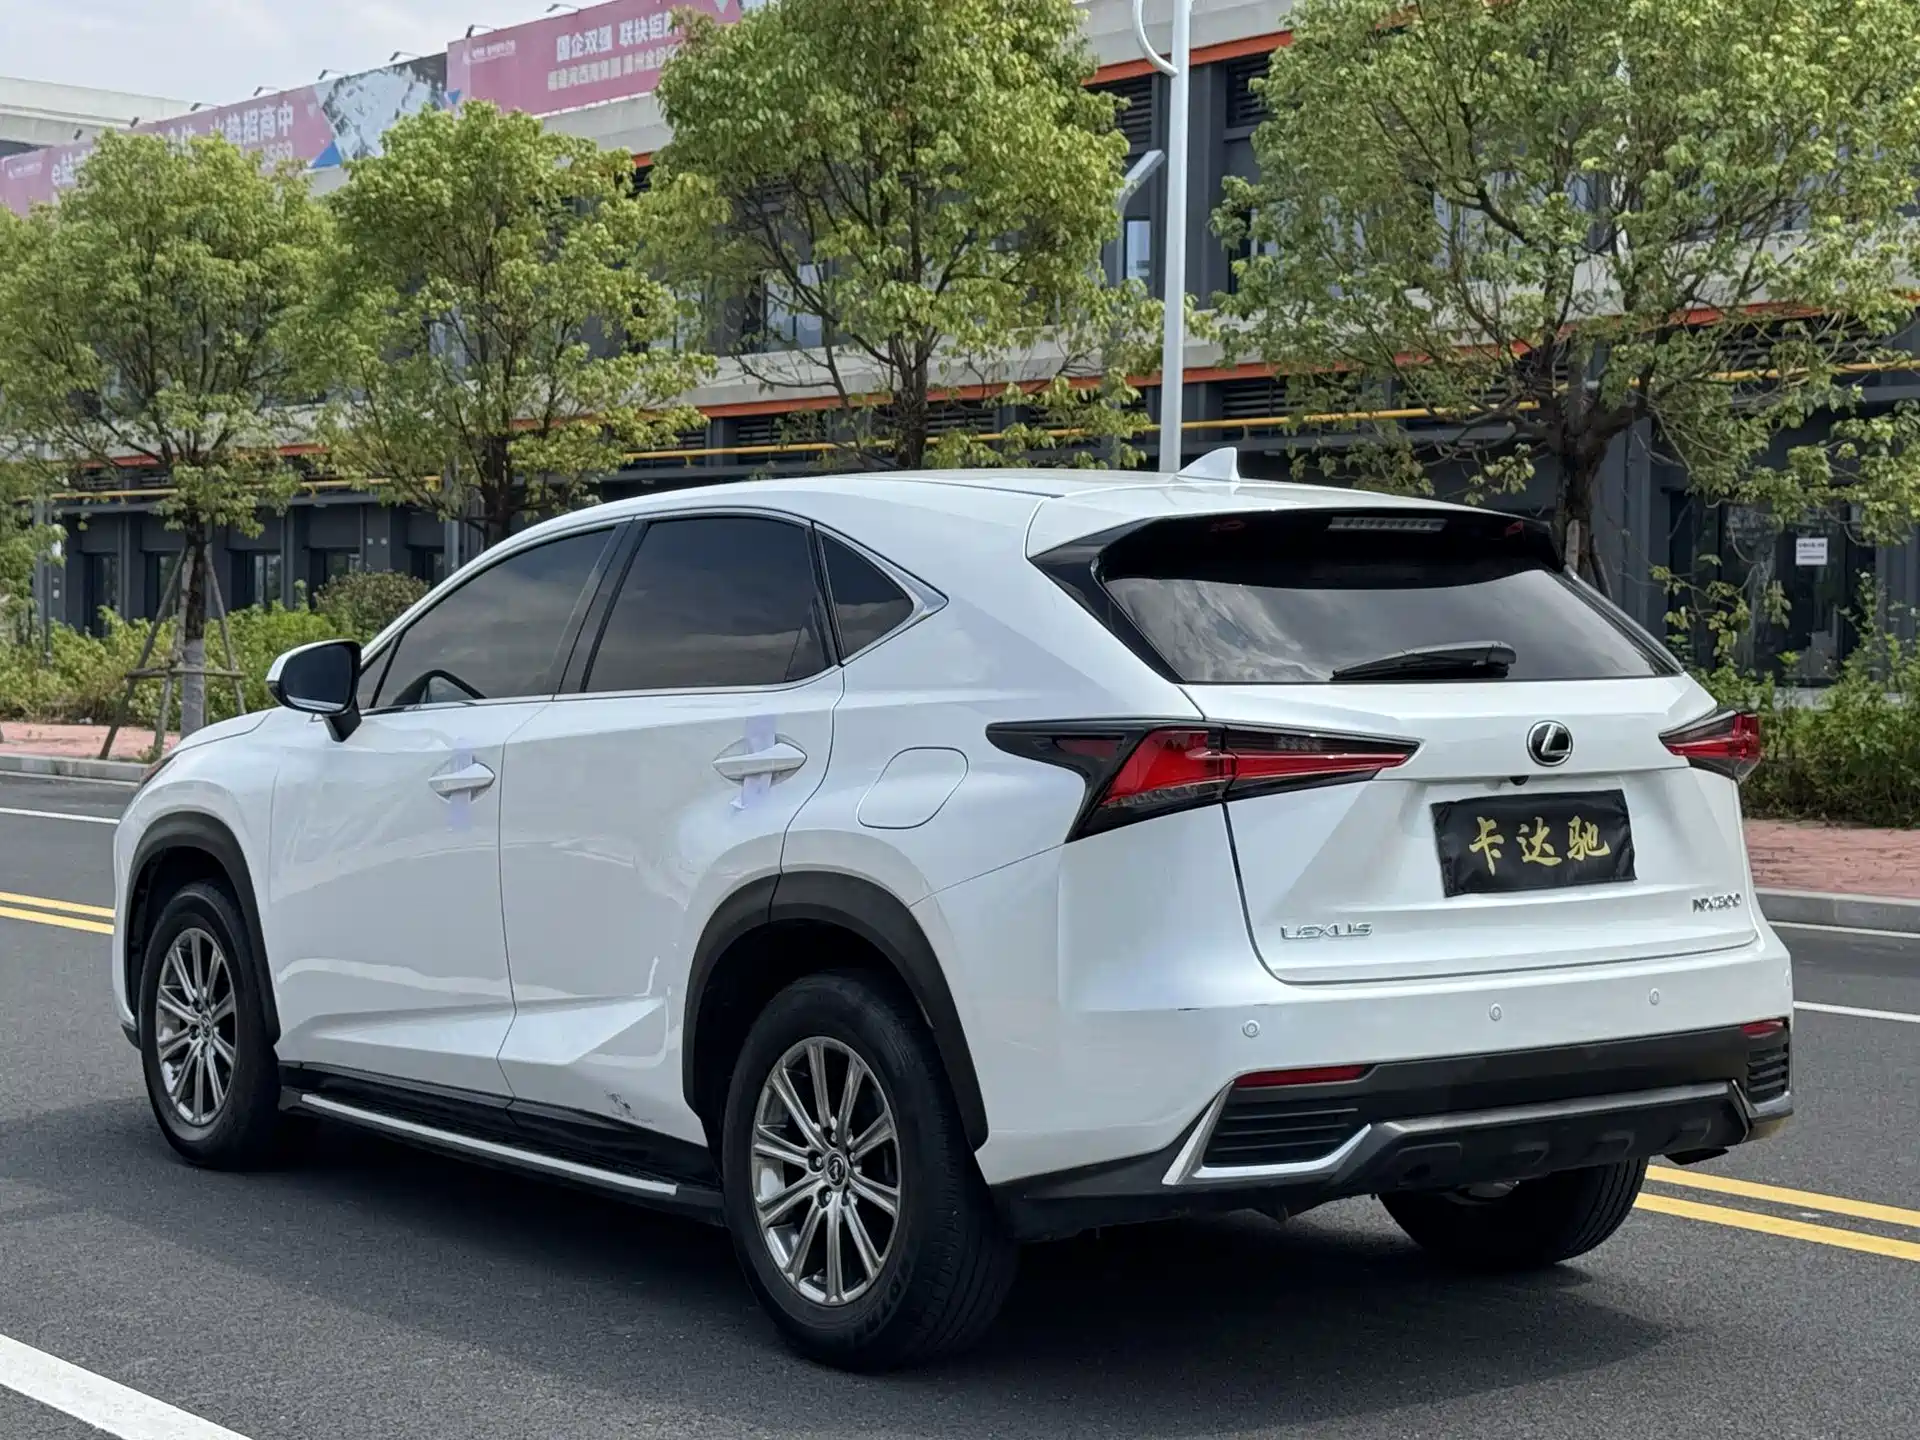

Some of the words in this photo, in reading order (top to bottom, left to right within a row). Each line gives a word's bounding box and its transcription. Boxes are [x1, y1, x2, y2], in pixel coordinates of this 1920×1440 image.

[1467, 813, 1612, 876] 卡达驰
[1691, 892, 1742, 913] NX300
[1279, 921, 1373, 941] LEXUS
